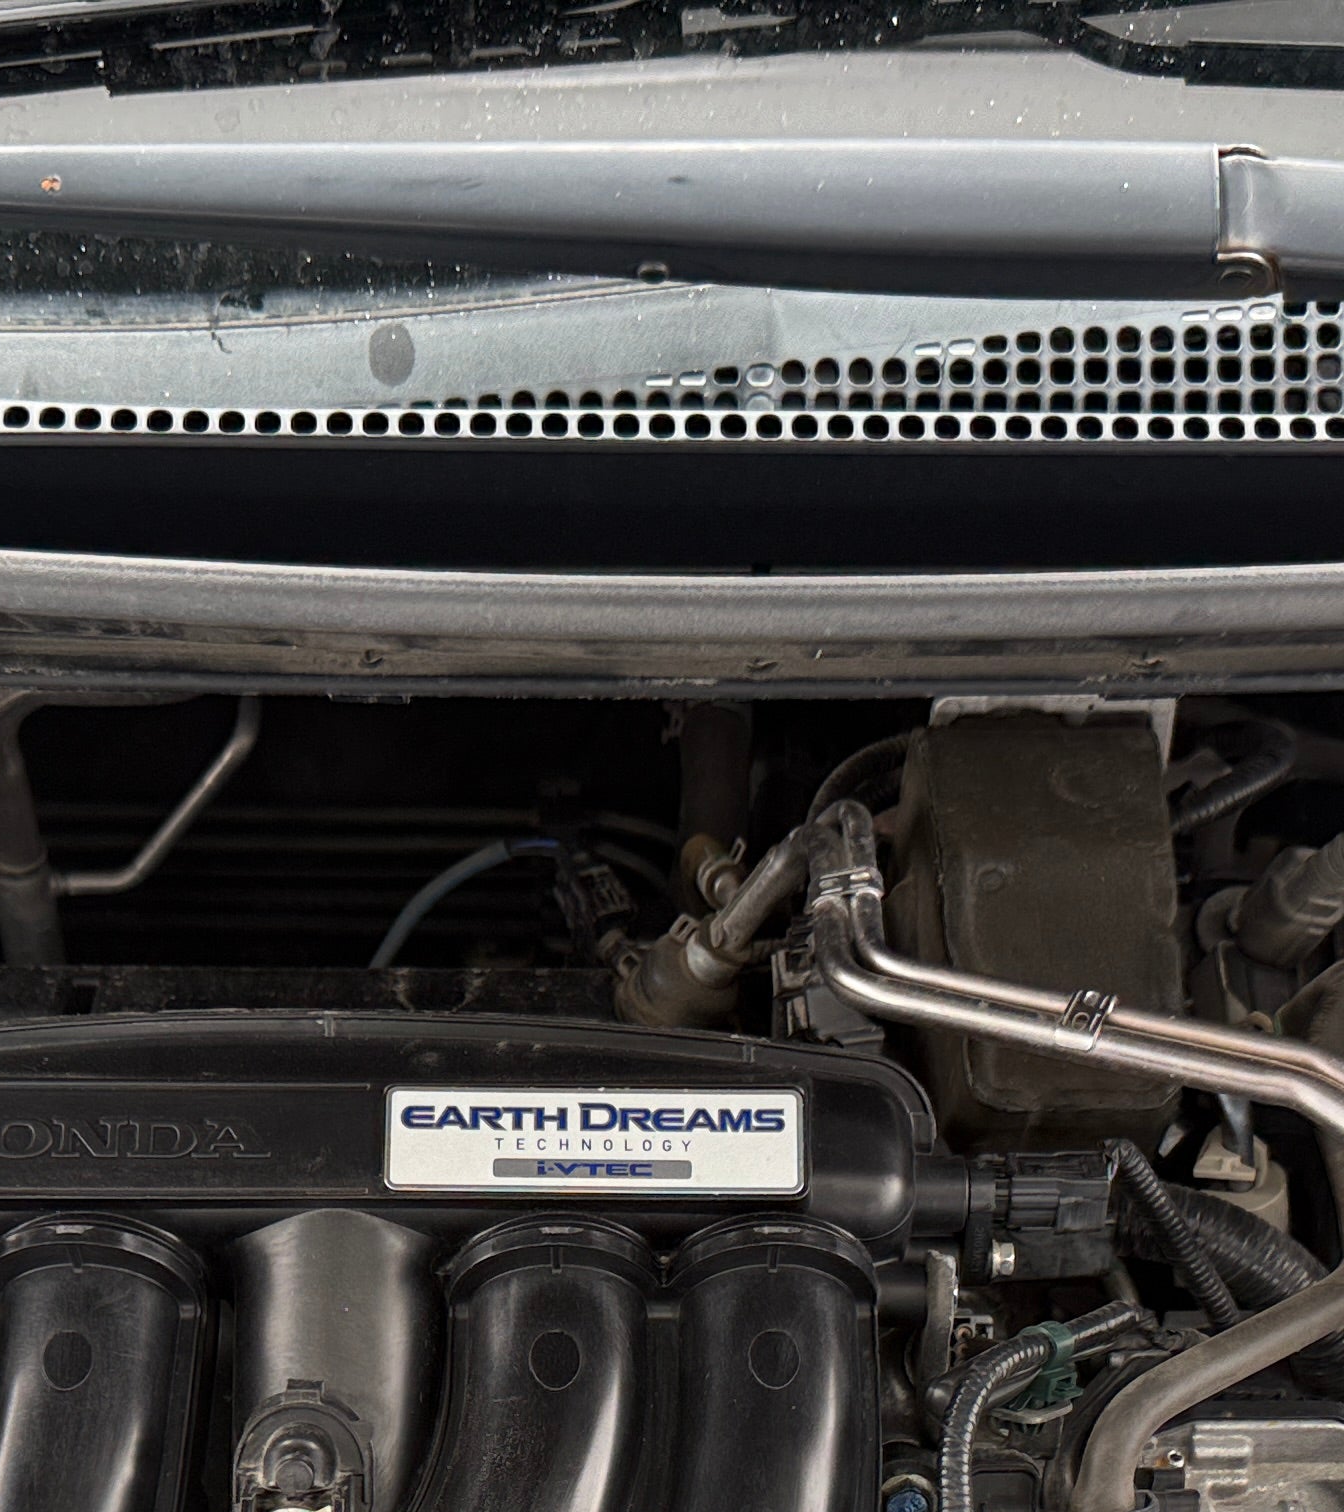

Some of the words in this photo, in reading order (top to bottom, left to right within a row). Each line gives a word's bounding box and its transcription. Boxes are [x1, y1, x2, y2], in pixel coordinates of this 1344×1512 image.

[400, 1105, 568, 1131] EARTH
[579, 1102, 786, 1133] DREAMS
[494, 1137, 693, 1153] TECHNOLOGY
[536, 1160, 654, 1177] i-VTEC
